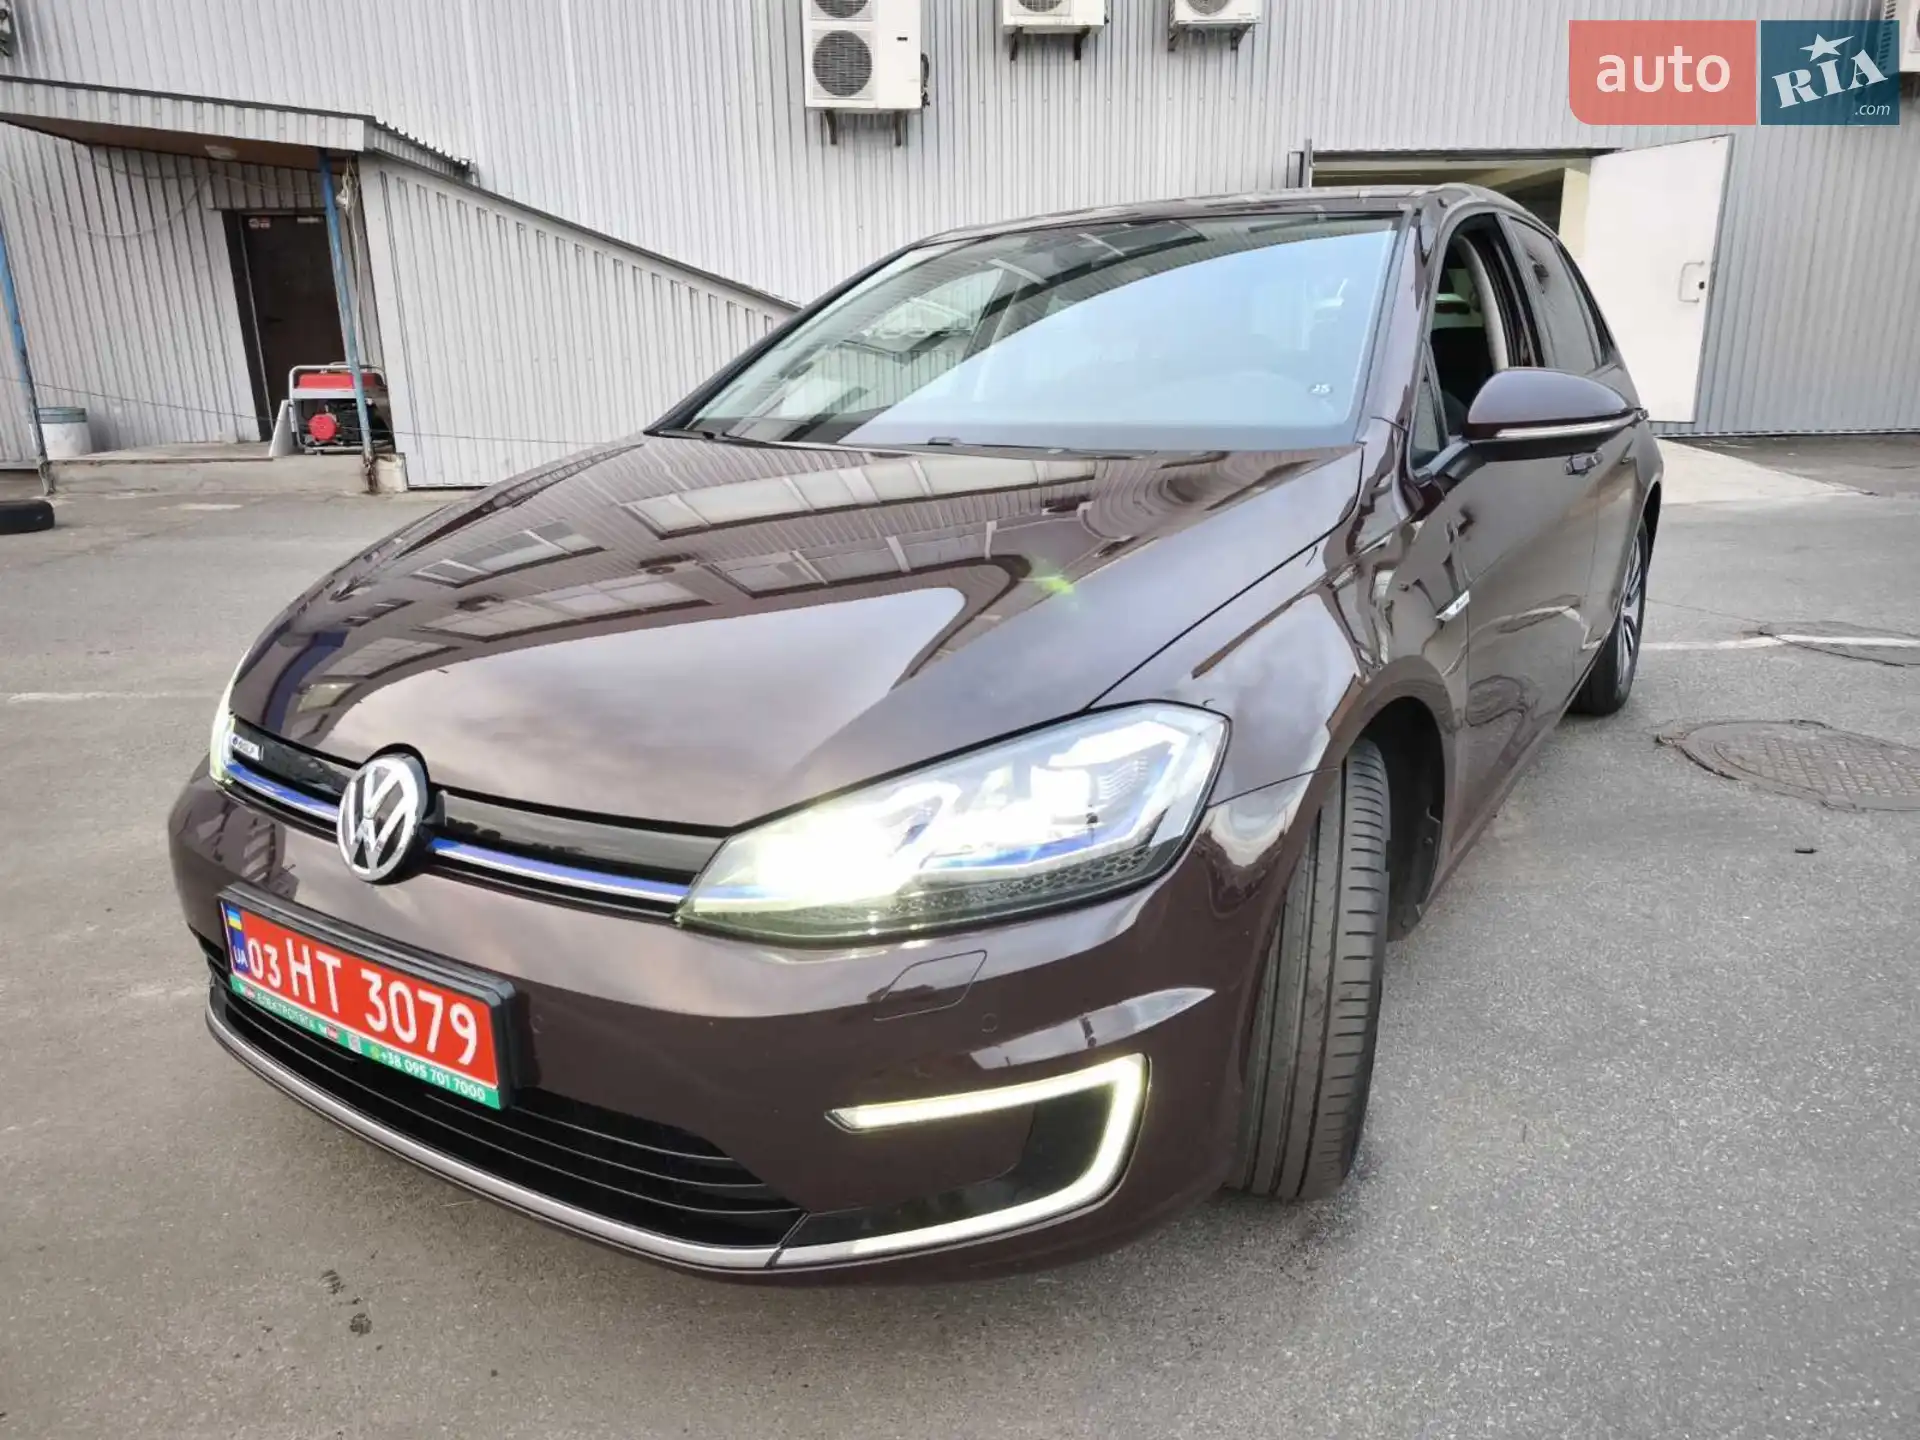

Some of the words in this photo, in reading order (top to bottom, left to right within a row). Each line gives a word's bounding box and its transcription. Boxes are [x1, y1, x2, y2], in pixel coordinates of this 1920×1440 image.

[233, 945, 249, 968] UA
[360, 968, 477, 1066] 3079
[430, 1068, 451, 1089] 701
[454, 1077, 486, 1101] 7000
